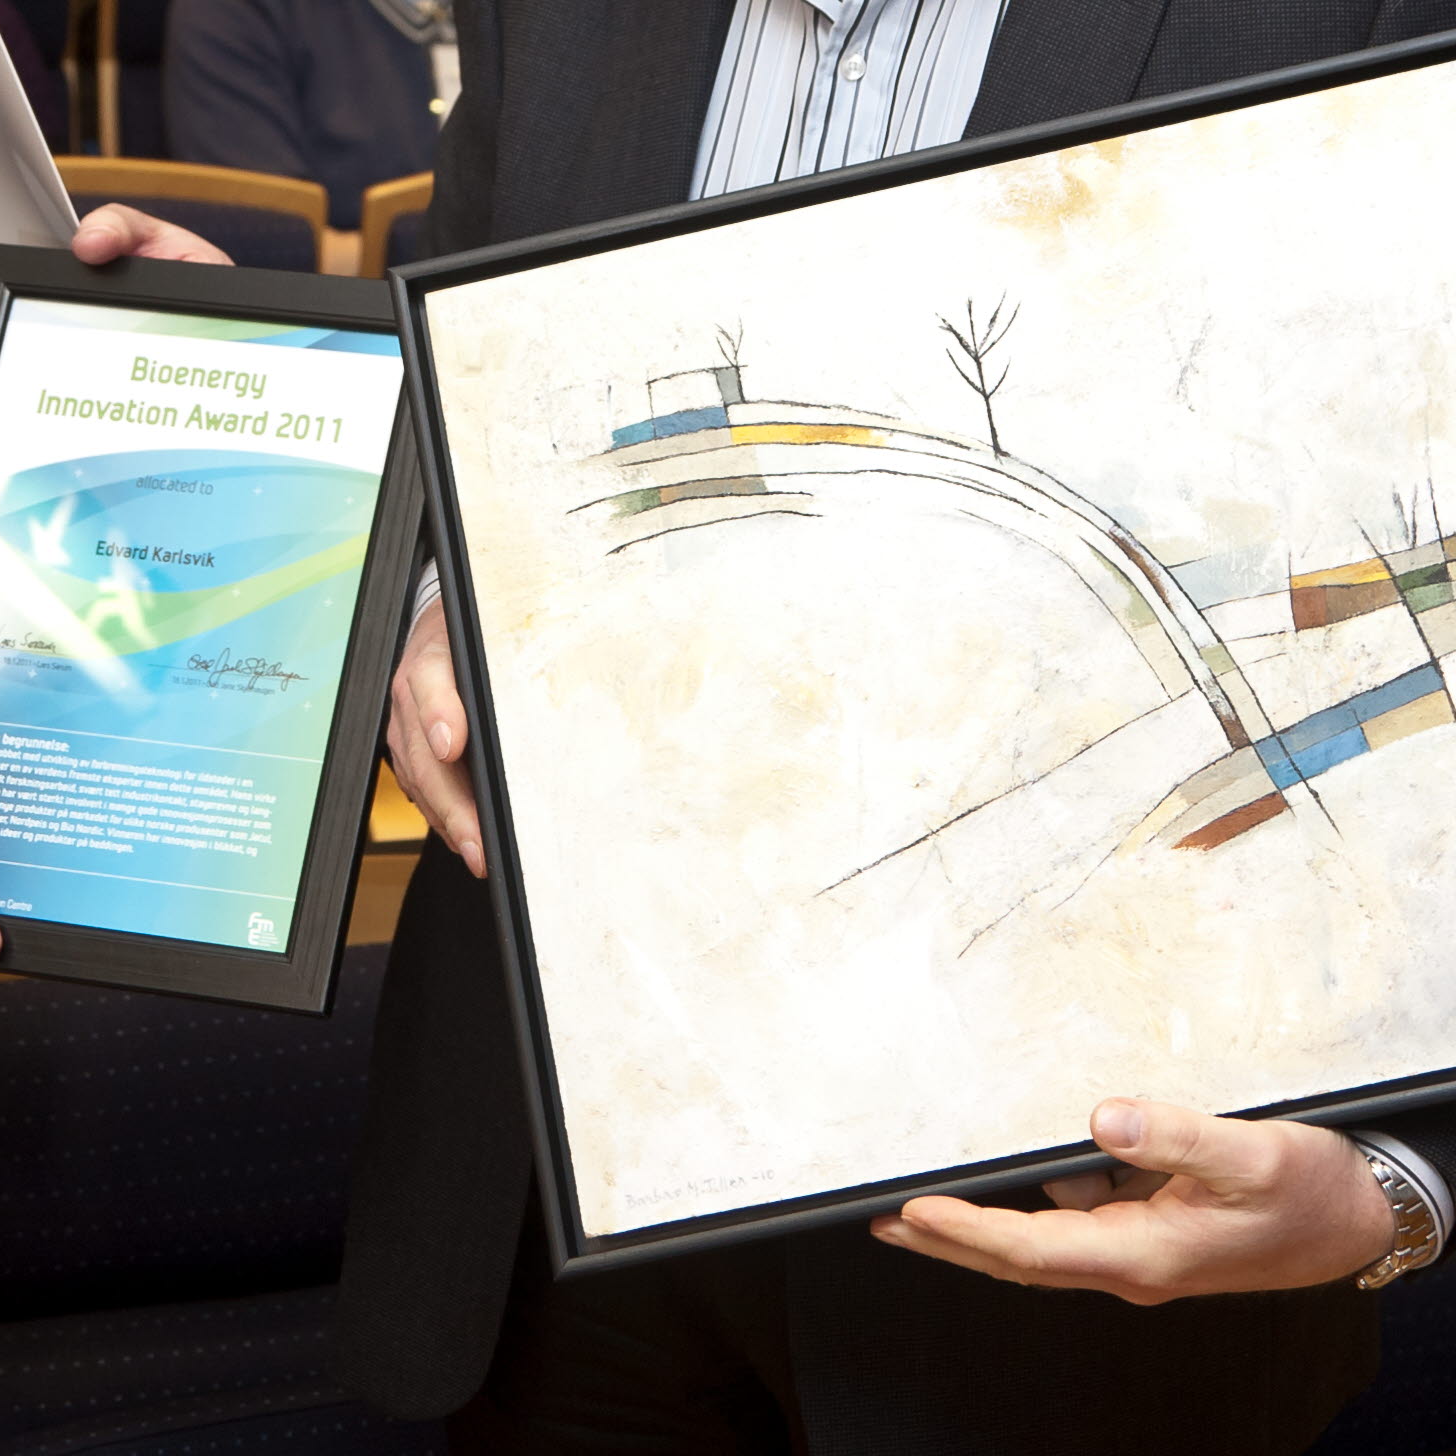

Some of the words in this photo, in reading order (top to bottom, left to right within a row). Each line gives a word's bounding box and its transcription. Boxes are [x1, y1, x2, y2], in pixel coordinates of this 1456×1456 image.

[130, 356, 267, 399] Bioenergy
[36, 389, 179, 428] Innovation
[184, 404, 269, 436] Award
[275, 412, 343, 443] 2011
[135, 475, 197, 495] allocated
[199, 482, 214, 496] to
[95, 540, 149, 561] Edvard
[152, 546, 215, 568] Karlsvik
